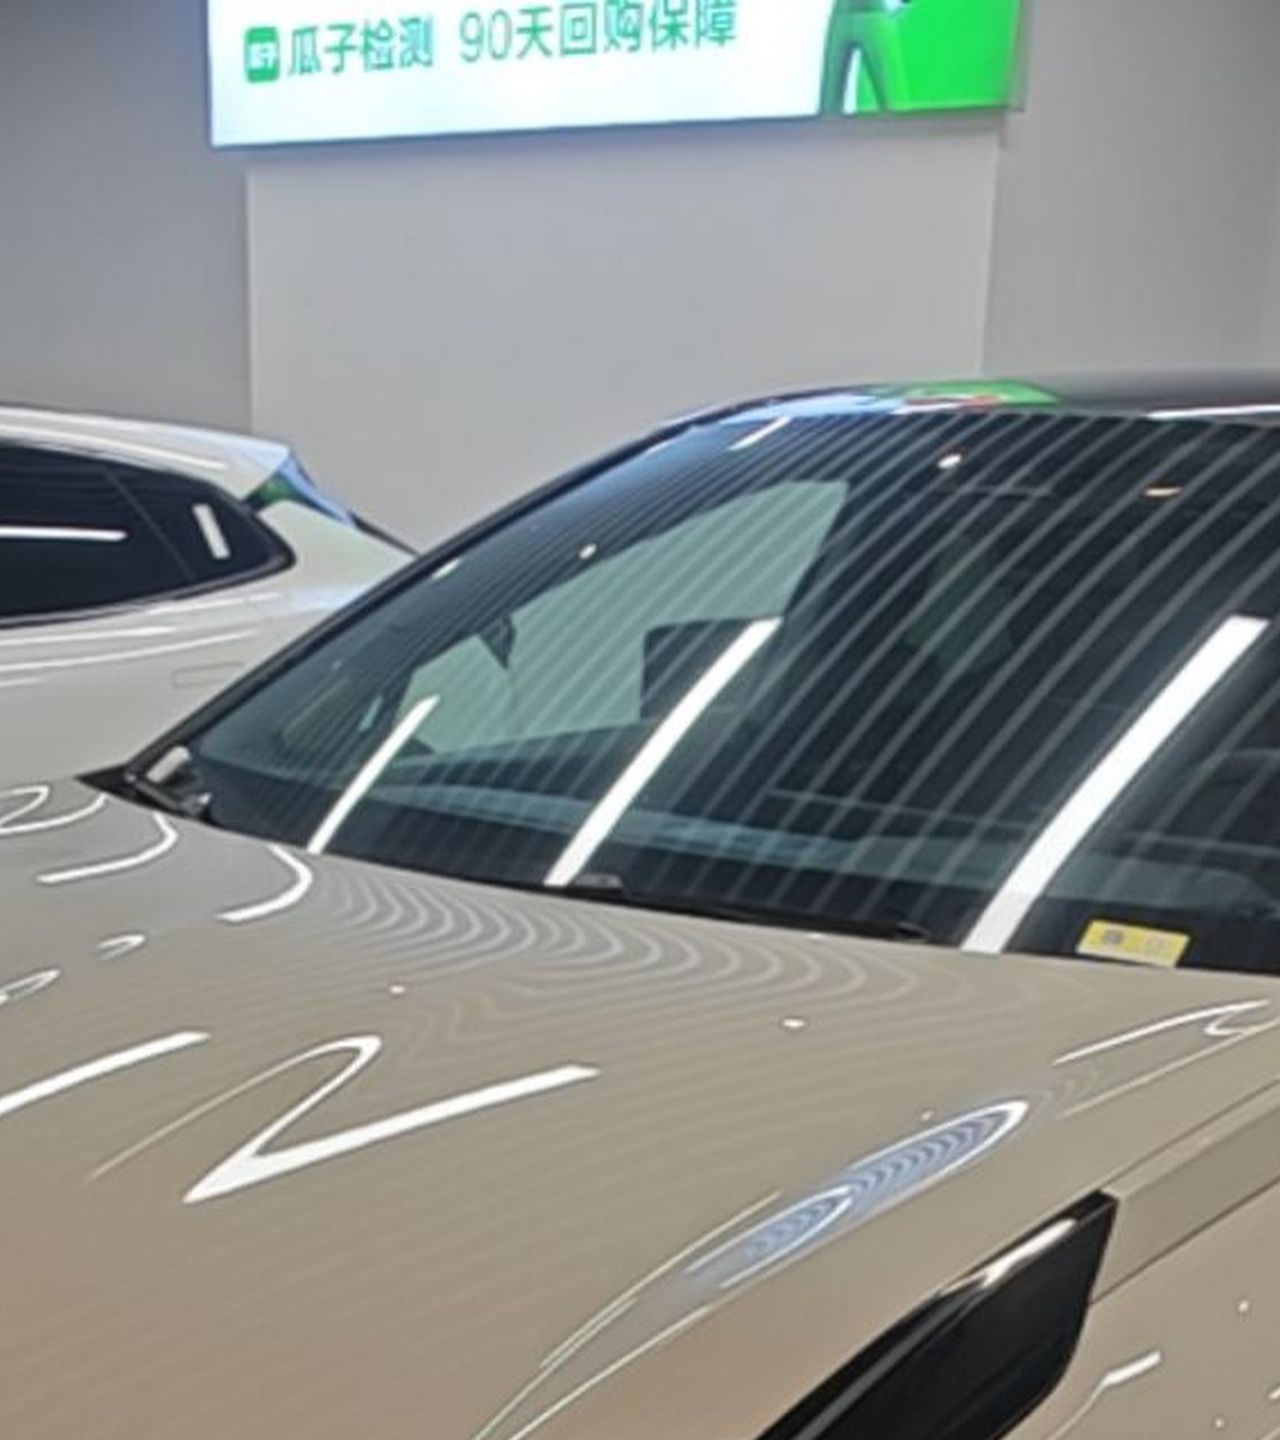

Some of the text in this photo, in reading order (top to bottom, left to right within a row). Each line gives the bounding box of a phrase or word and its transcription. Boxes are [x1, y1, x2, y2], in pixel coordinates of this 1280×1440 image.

[288, 17, 434, 75] 瓜子检测
[460, 0, 736, 62] 90天回购保障
